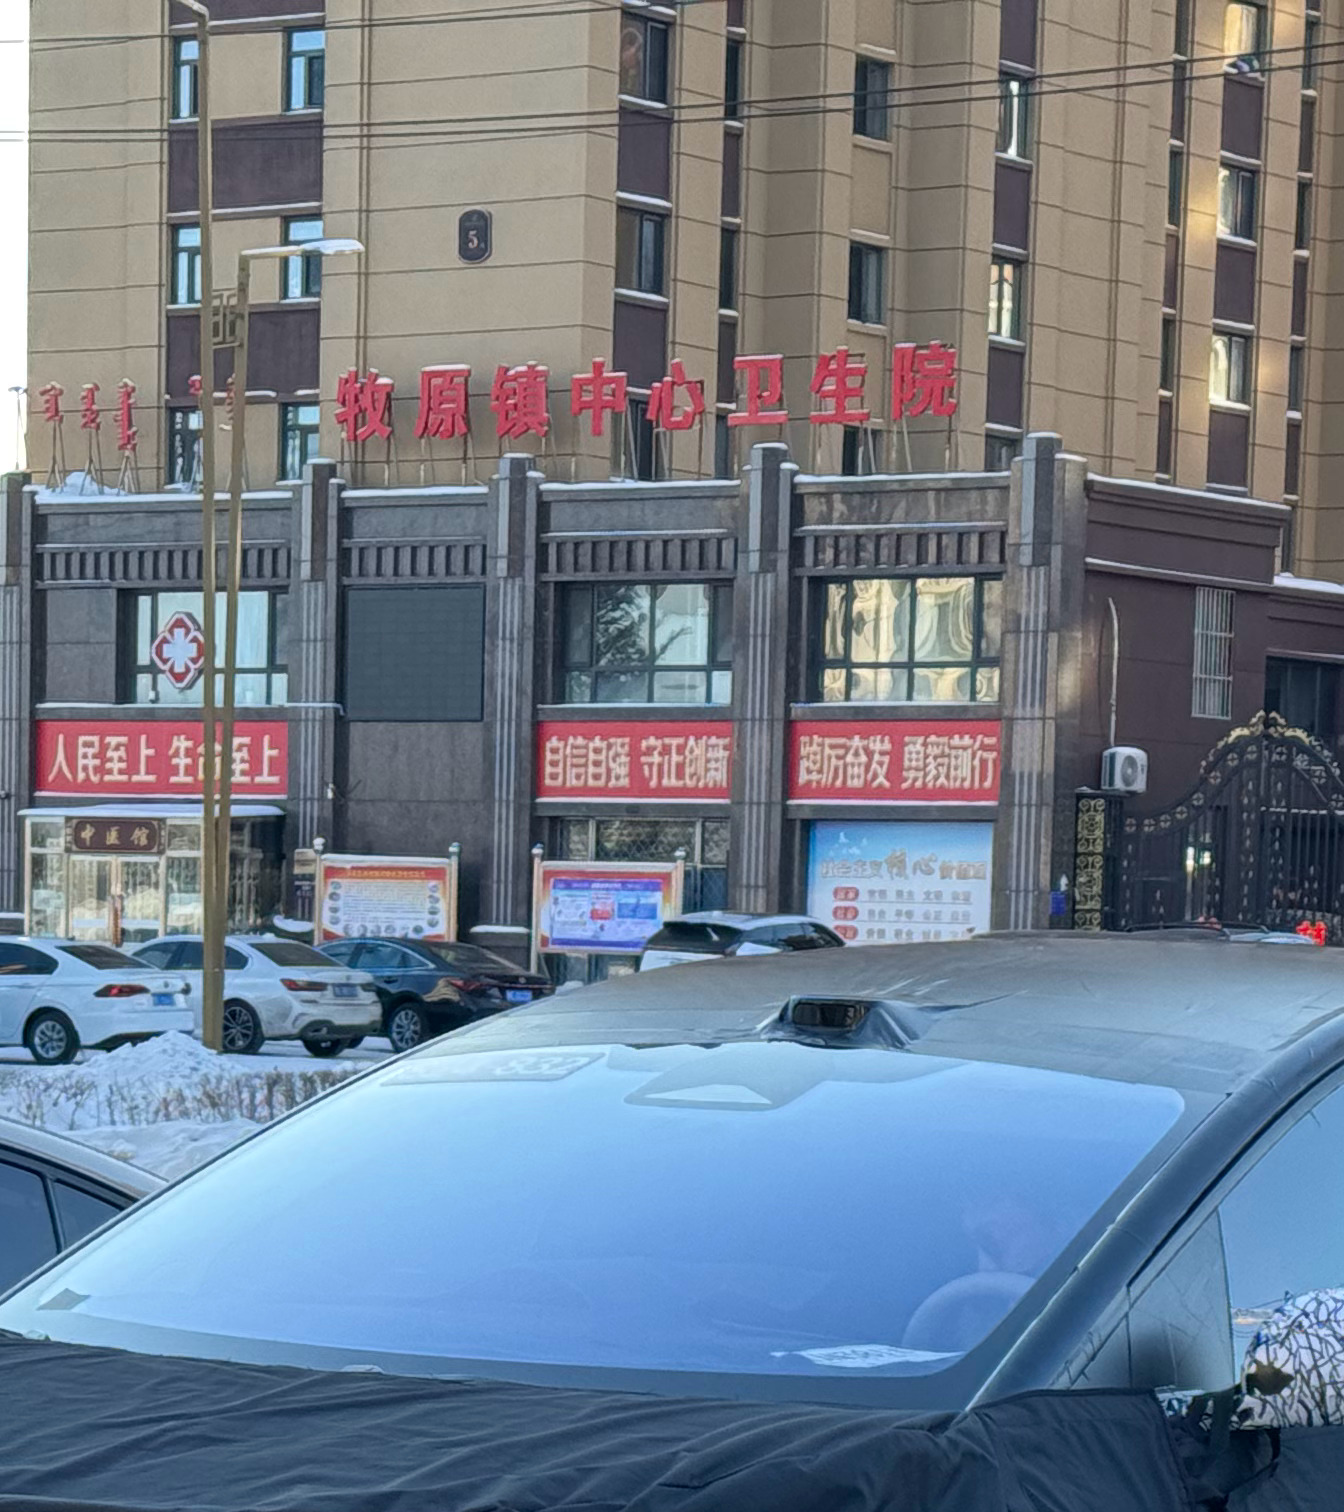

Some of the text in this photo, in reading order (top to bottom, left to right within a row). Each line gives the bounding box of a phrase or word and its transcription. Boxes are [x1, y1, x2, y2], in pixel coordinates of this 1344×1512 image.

[467, 230, 478, 249] 5
[334, 341, 956, 441] 牧原镇中心卫生院
[48, 733, 157, 783] 人民至上
[544, 735, 730, 788] 自信自强 守正创新
[799, 734, 998, 789] 踔厉奋发 勇毅前行
[80, 822, 150, 847] 中医馆
